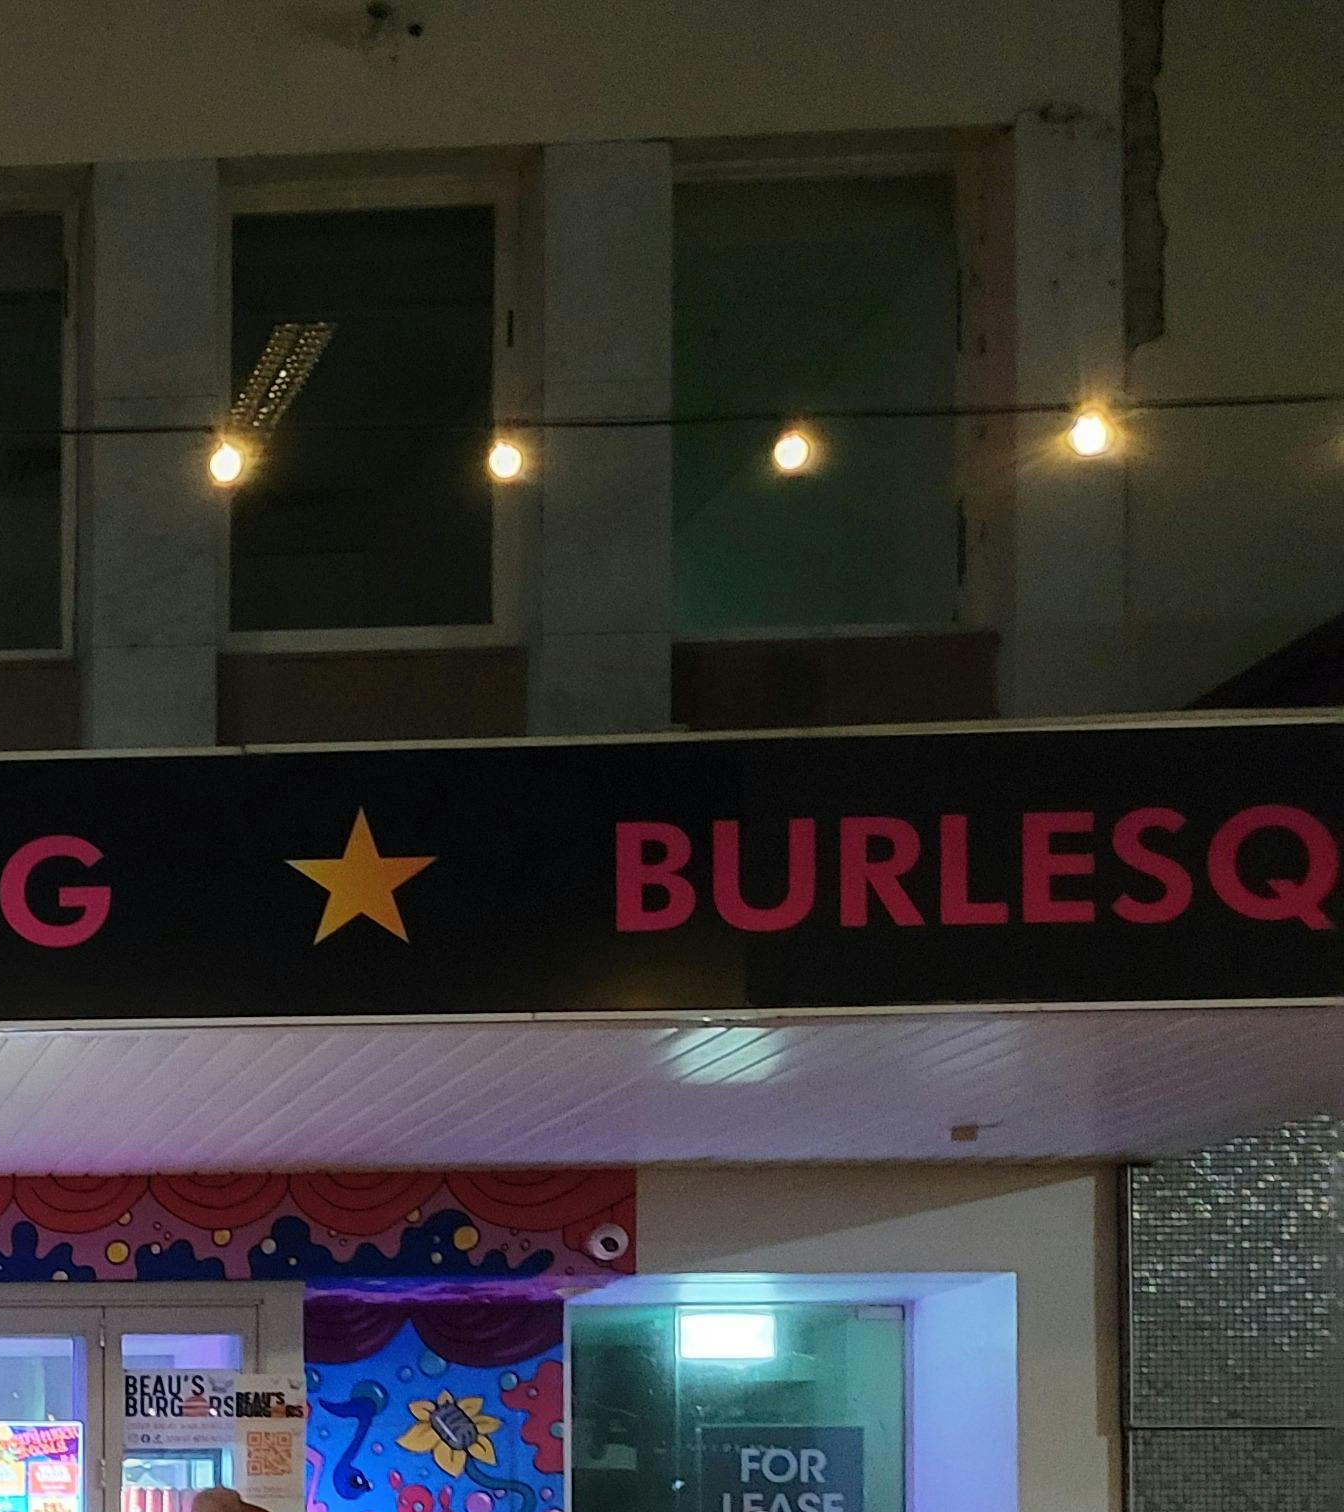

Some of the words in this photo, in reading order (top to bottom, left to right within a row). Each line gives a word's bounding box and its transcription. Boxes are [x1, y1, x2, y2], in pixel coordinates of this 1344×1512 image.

[613, 804, 1338, 934] BURLESQ
[124, 1374, 205, 1396] BEAU'S
[124, 1395, 234, 1418] BURGRS
[740, 1448, 827, 1483] FOR
